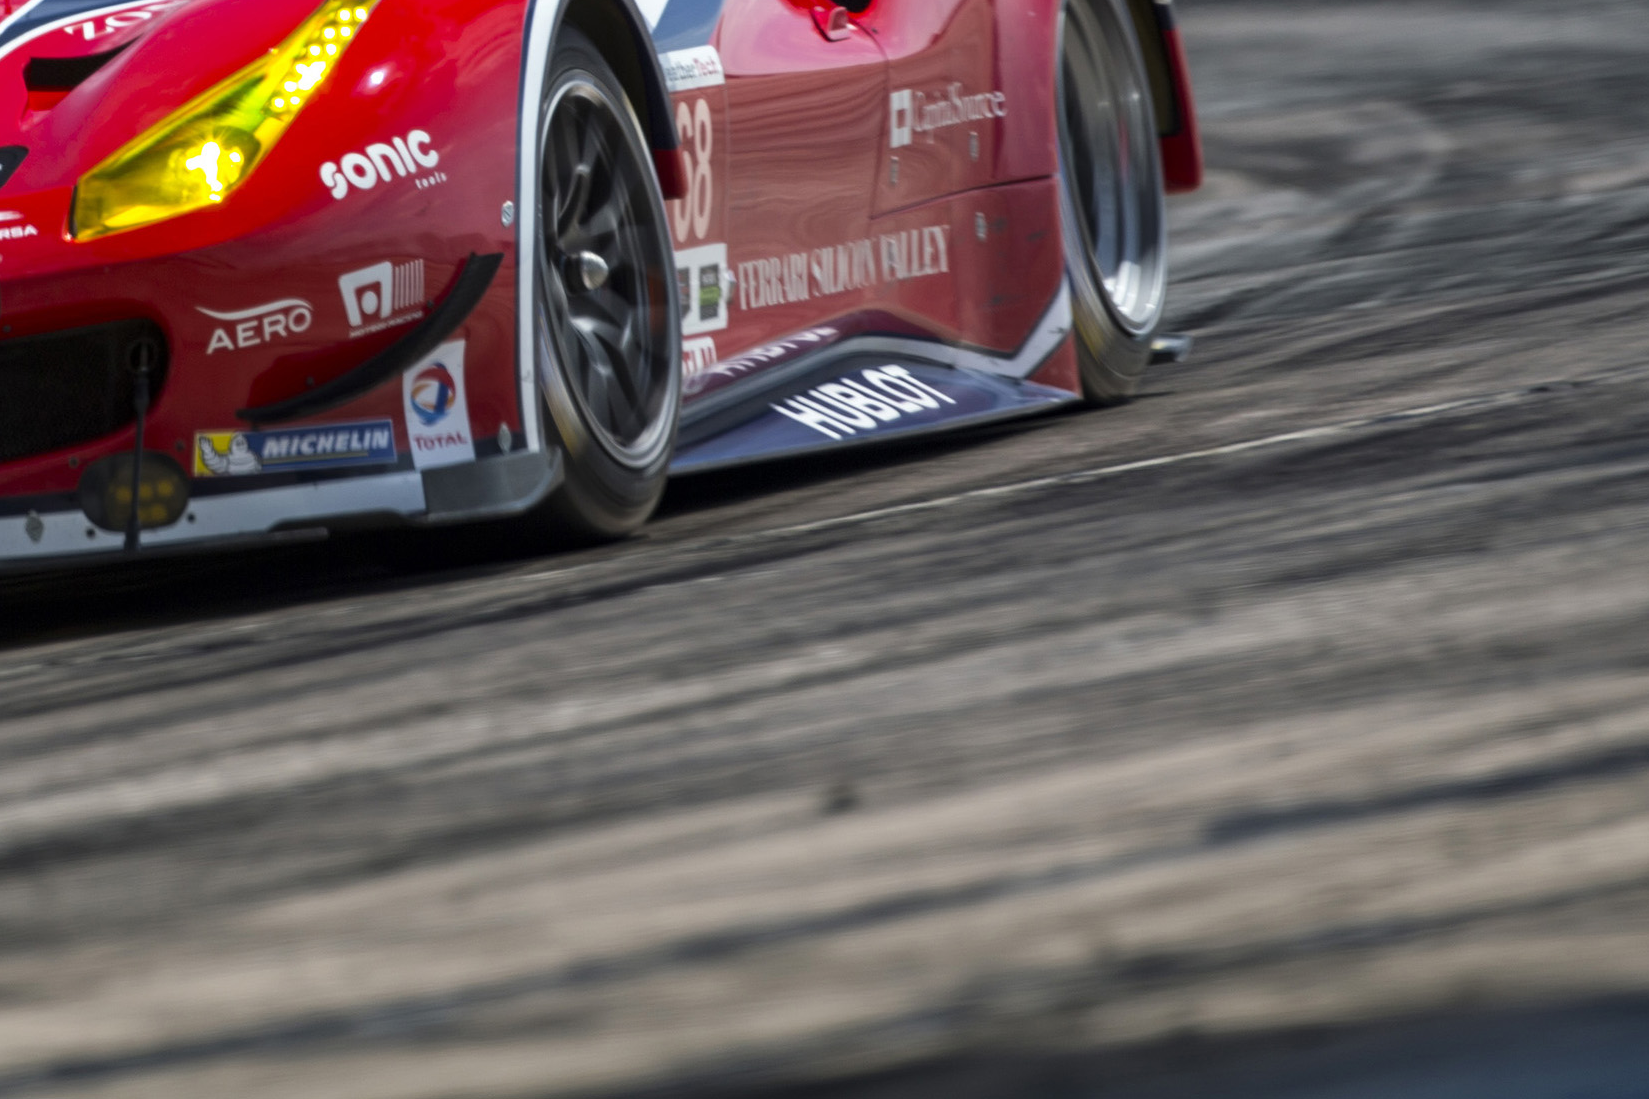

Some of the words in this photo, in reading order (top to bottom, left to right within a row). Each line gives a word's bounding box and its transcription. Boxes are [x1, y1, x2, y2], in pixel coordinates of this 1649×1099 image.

[673, 98, 713, 243] 68
[738, 252, 810, 311] FERRARI
[878, 224, 950, 284] VALLEY
[206, 307, 312, 355] AERO
[770, 364, 956, 441] HUBLOT
[261, 427, 390, 460] MICHELIN
[413, 435, 469, 452] TOTAL
